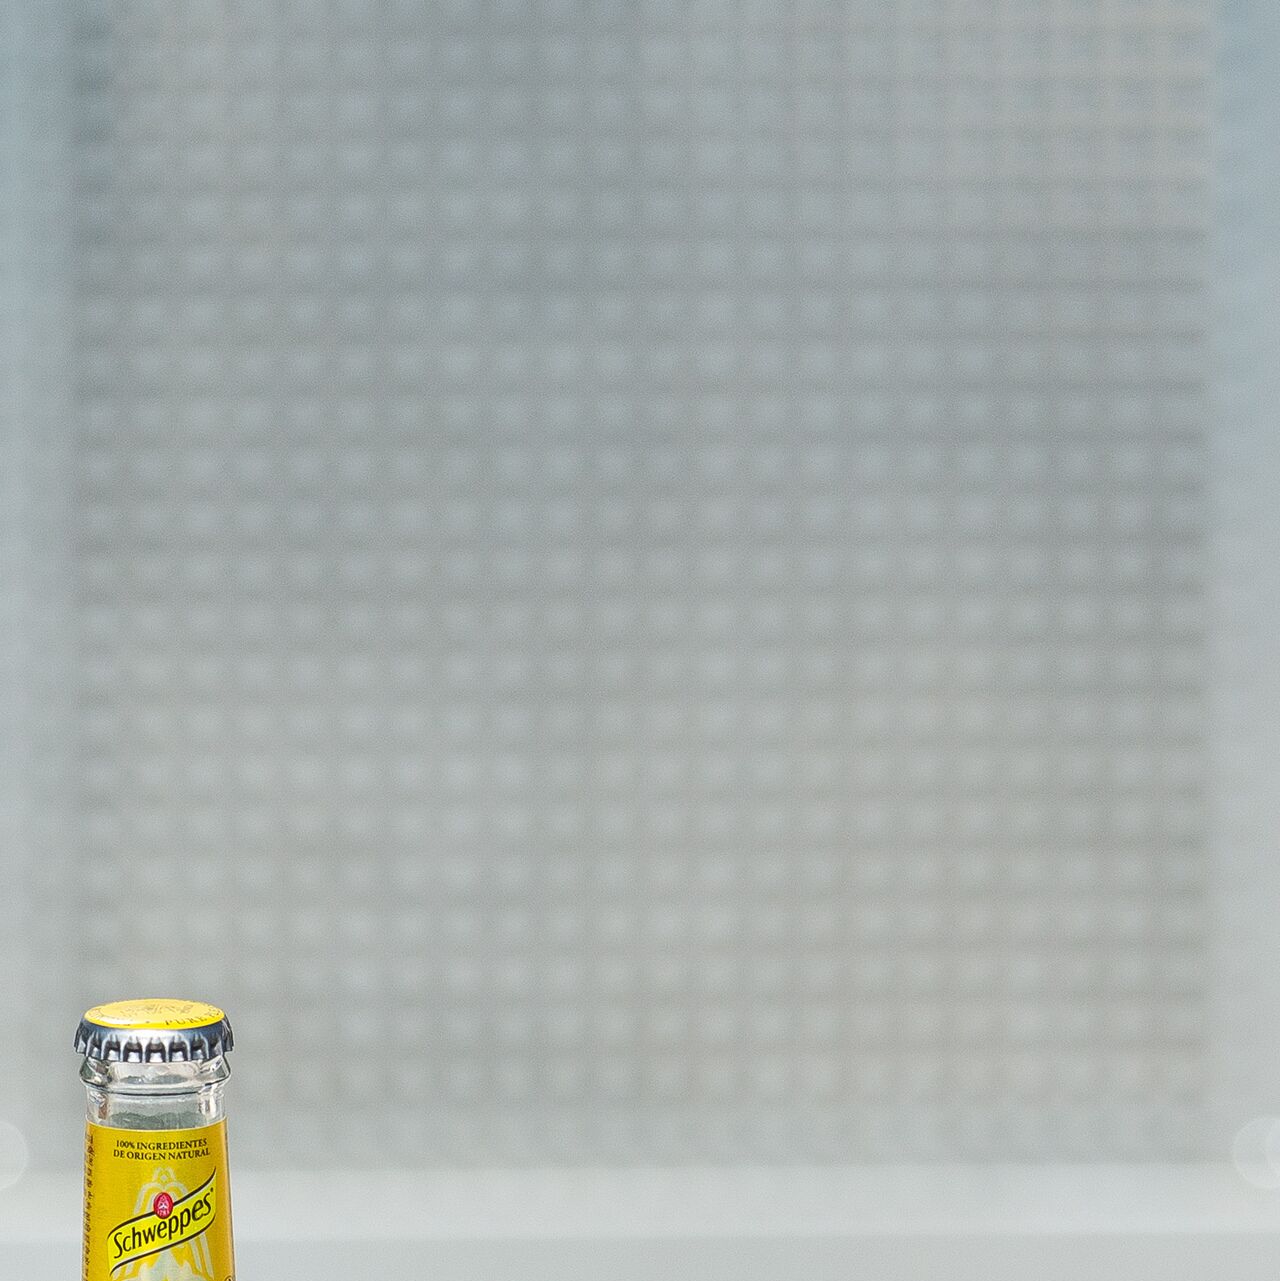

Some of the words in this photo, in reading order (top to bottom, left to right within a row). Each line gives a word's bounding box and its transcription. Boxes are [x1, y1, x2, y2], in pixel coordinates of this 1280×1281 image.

[115, 1139, 136, 1150] 100%
[136, 1138, 208, 1151] INGREDIENTES
[112, 1149, 127, 1158] DE
[127, 1150, 167, 1161] ORIGEN
[167, 1149, 211, 1161] NATURAL
[113, 1193, 213, 1260] Schweppes
